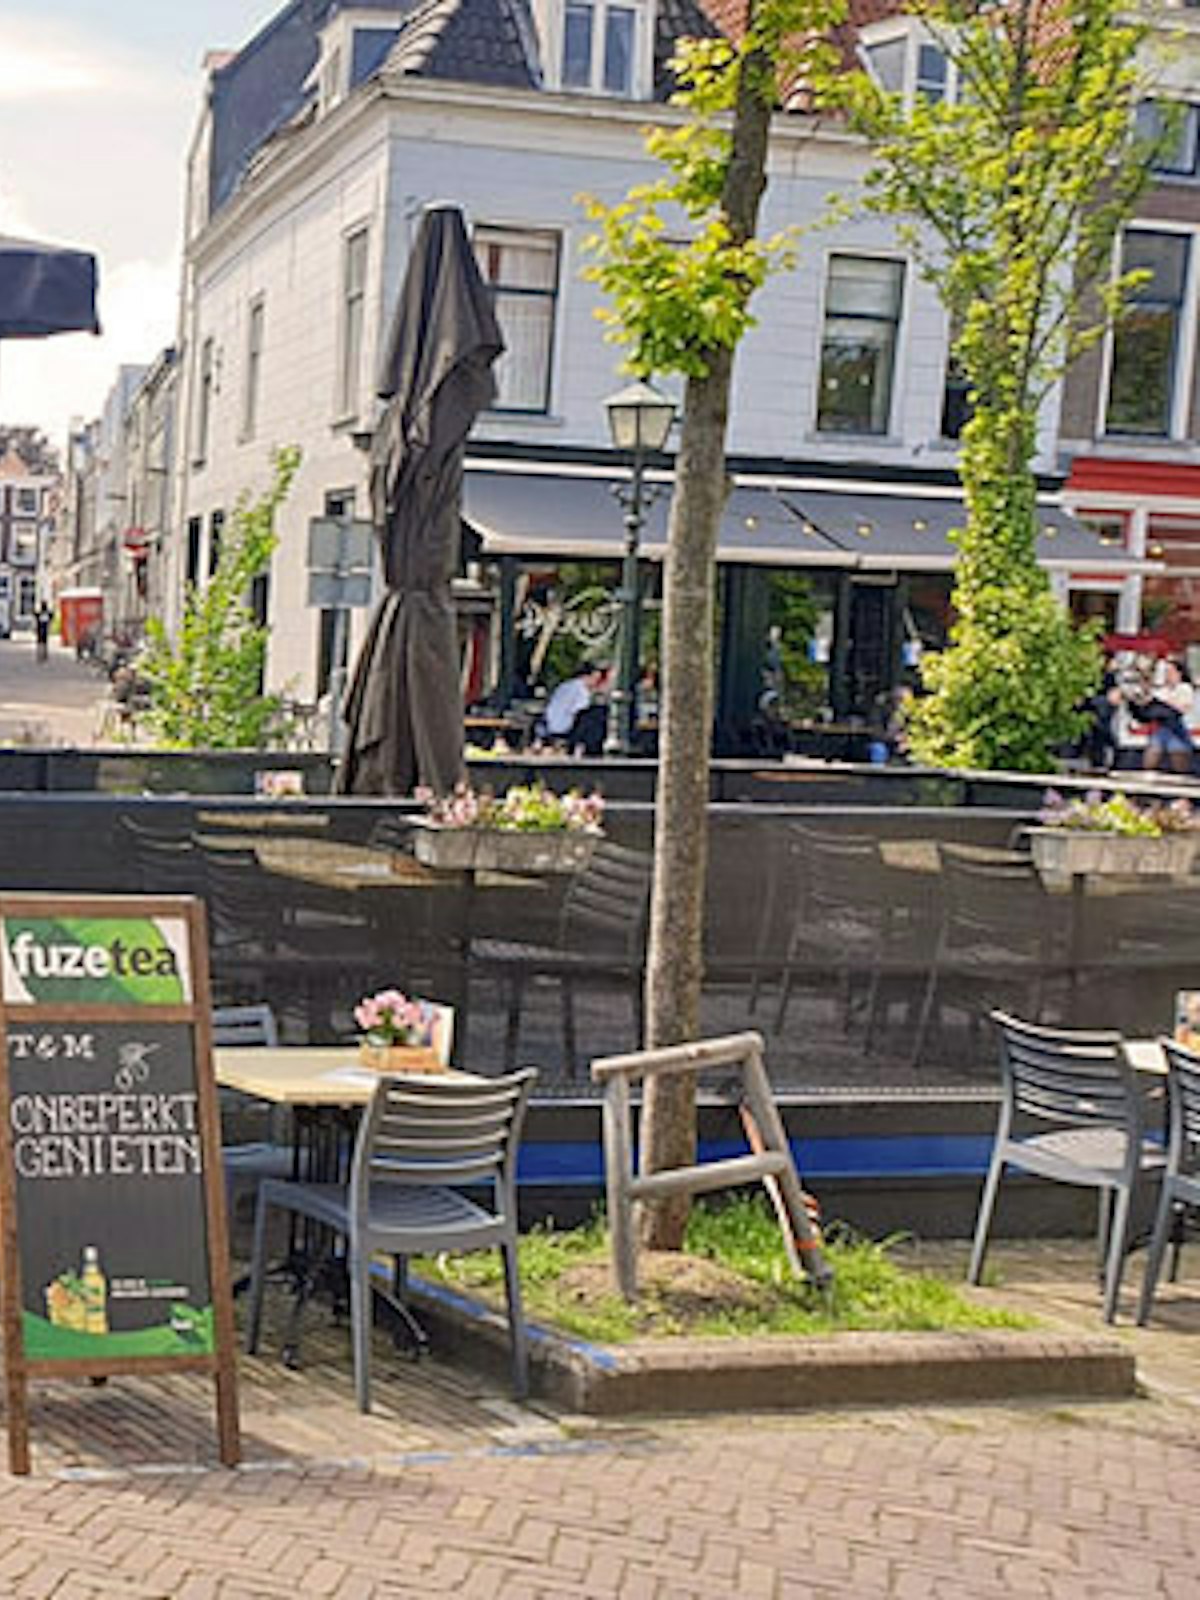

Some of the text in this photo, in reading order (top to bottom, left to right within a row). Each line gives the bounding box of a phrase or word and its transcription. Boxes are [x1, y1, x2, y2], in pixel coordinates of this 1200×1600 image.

[11, 930, 178, 978] fuzetea
[10, 1092, 198, 1133] ONBEPERKT
[14, 1134, 202, 1178] GENIETEN
